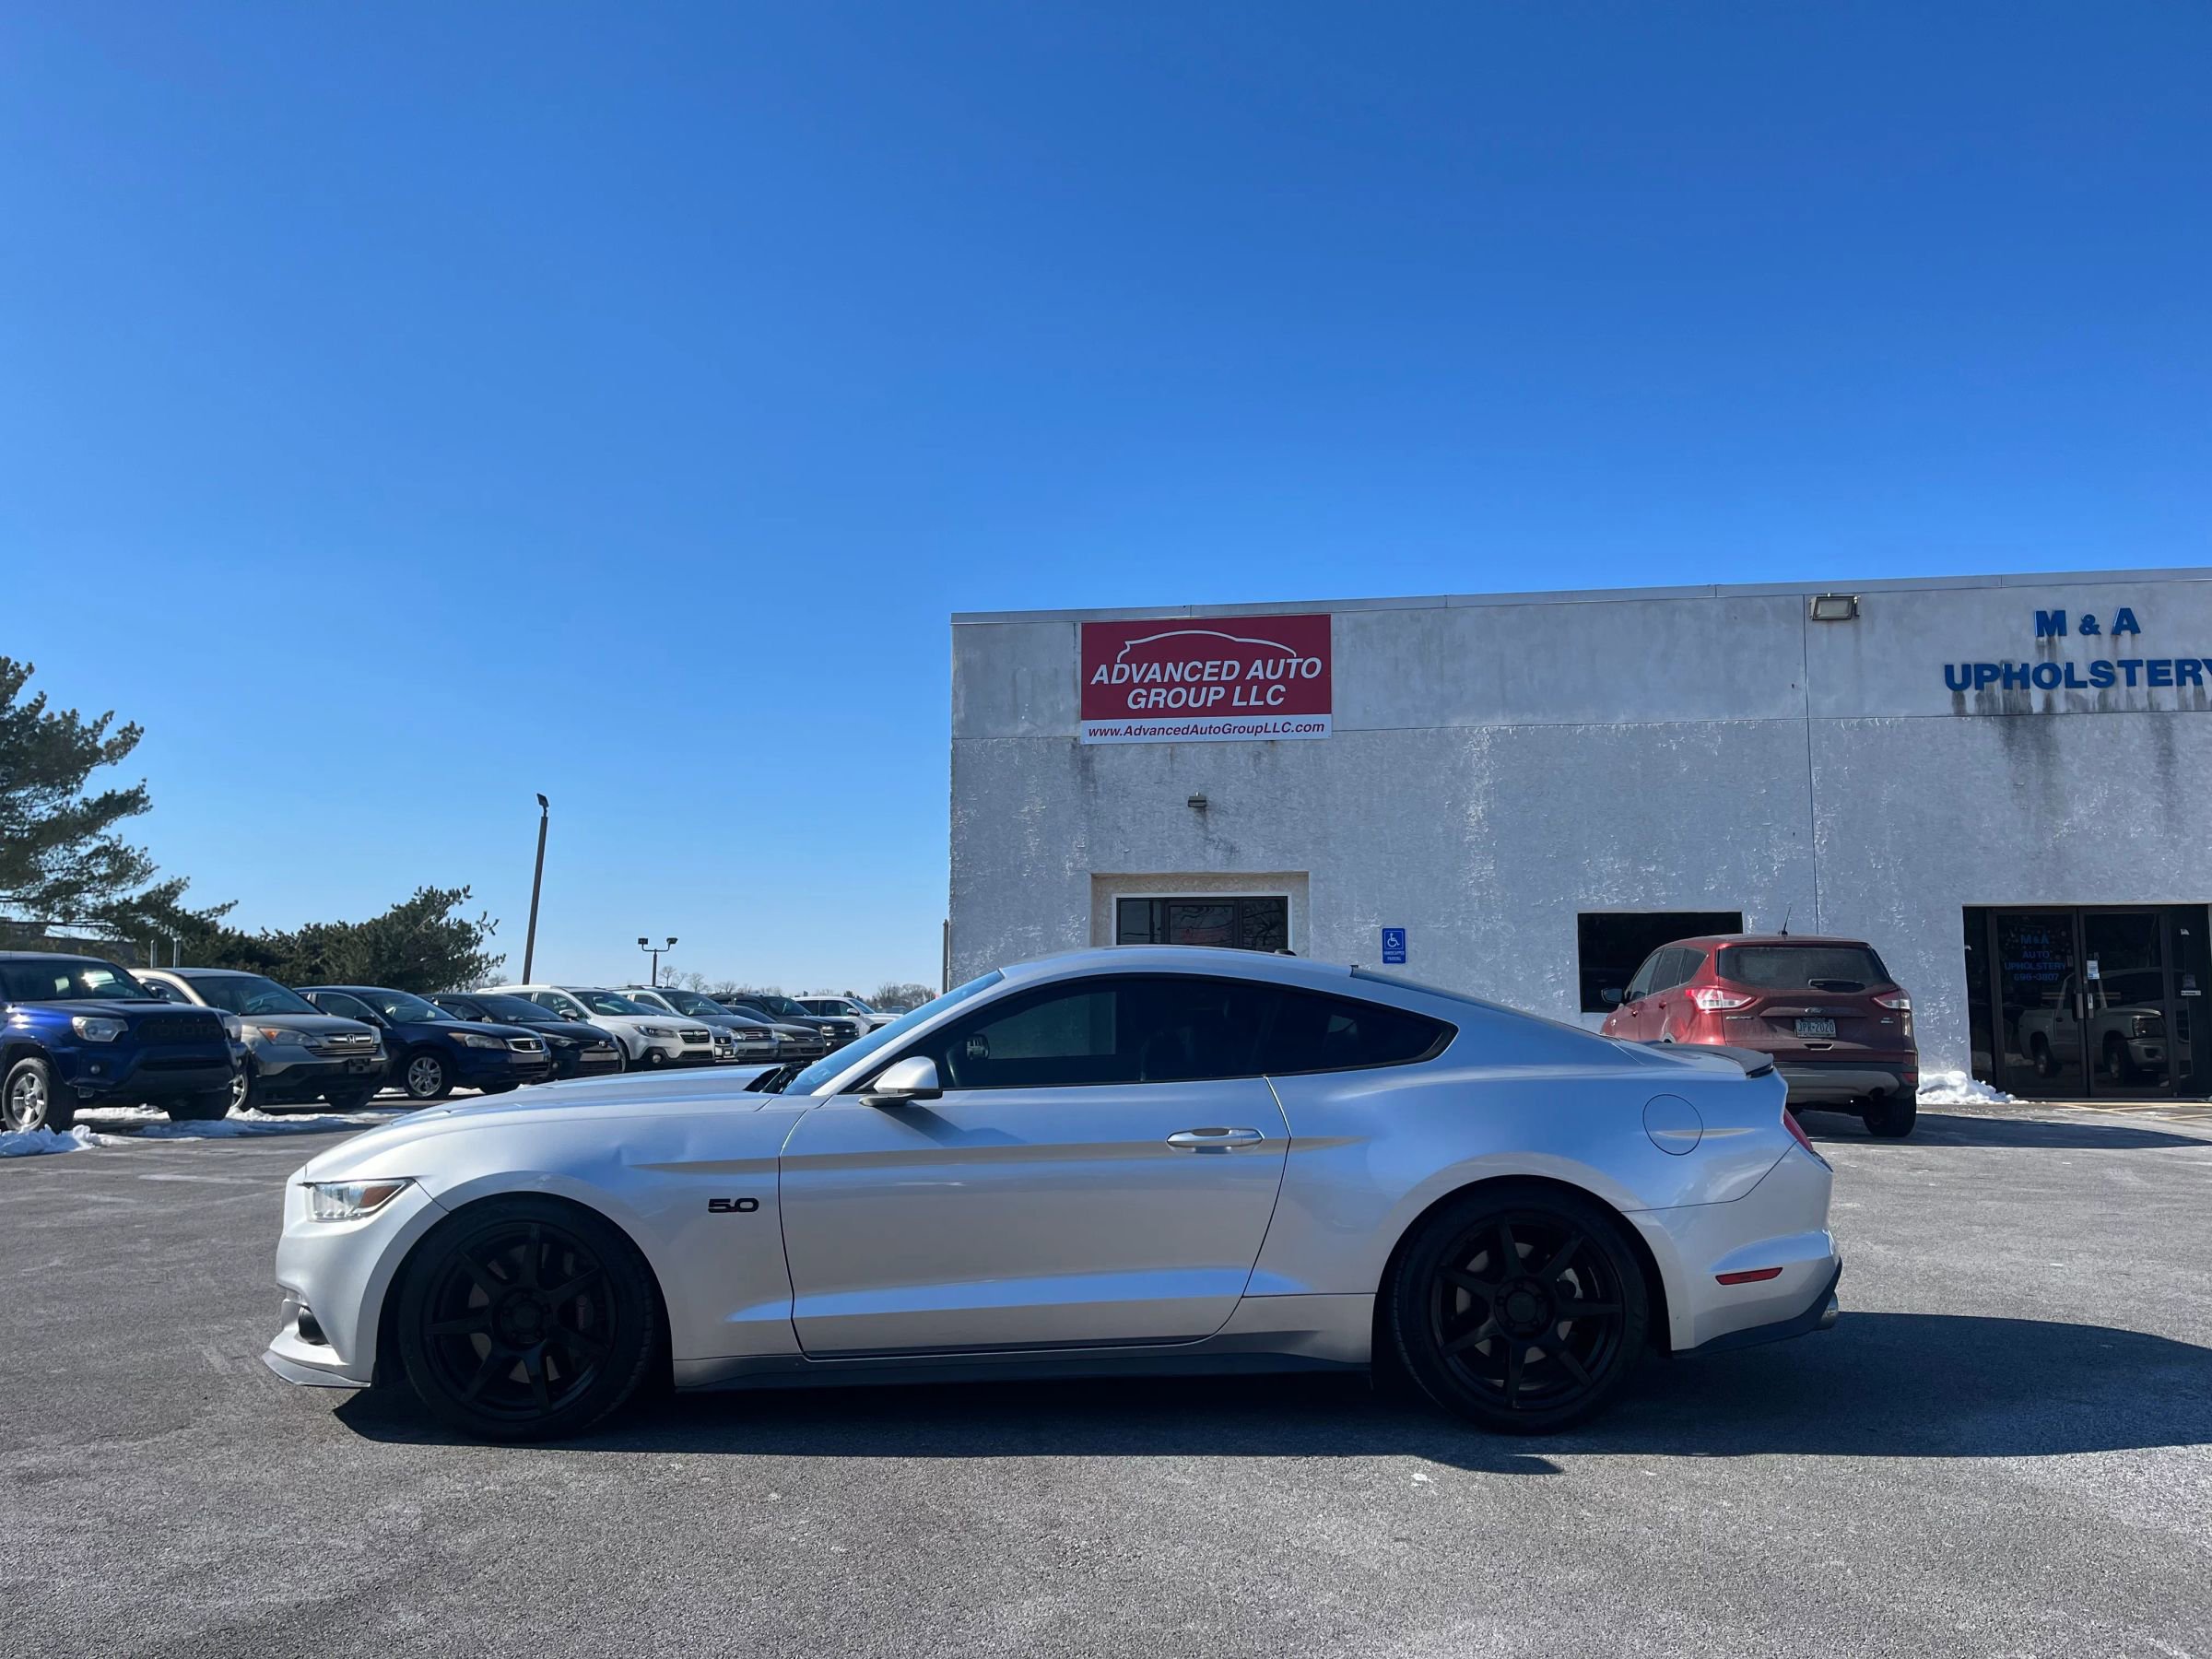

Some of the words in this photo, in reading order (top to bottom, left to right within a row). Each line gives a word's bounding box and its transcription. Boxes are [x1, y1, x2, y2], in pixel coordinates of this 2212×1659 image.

[2034, 609, 2067, 637] M
[2078, 614, 2101, 635] &
[2111, 607, 2141, 635] A
[1090, 660, 1241, 685] ADVANCED
[1245, 657, 1323, 680] AUTO
[1127, 687, 1225, 710] GROUP
[1231, 685, 1287, 707] LLC
[1088, 722, 1325, 737] www.AdvancedAutoGroupLLC.com
[2022, 951, 2051, 959] AUTO
[2004, 961, 2065, 971] UPHOLSTERY
[708, 1197, 759, 1214] 5.0
